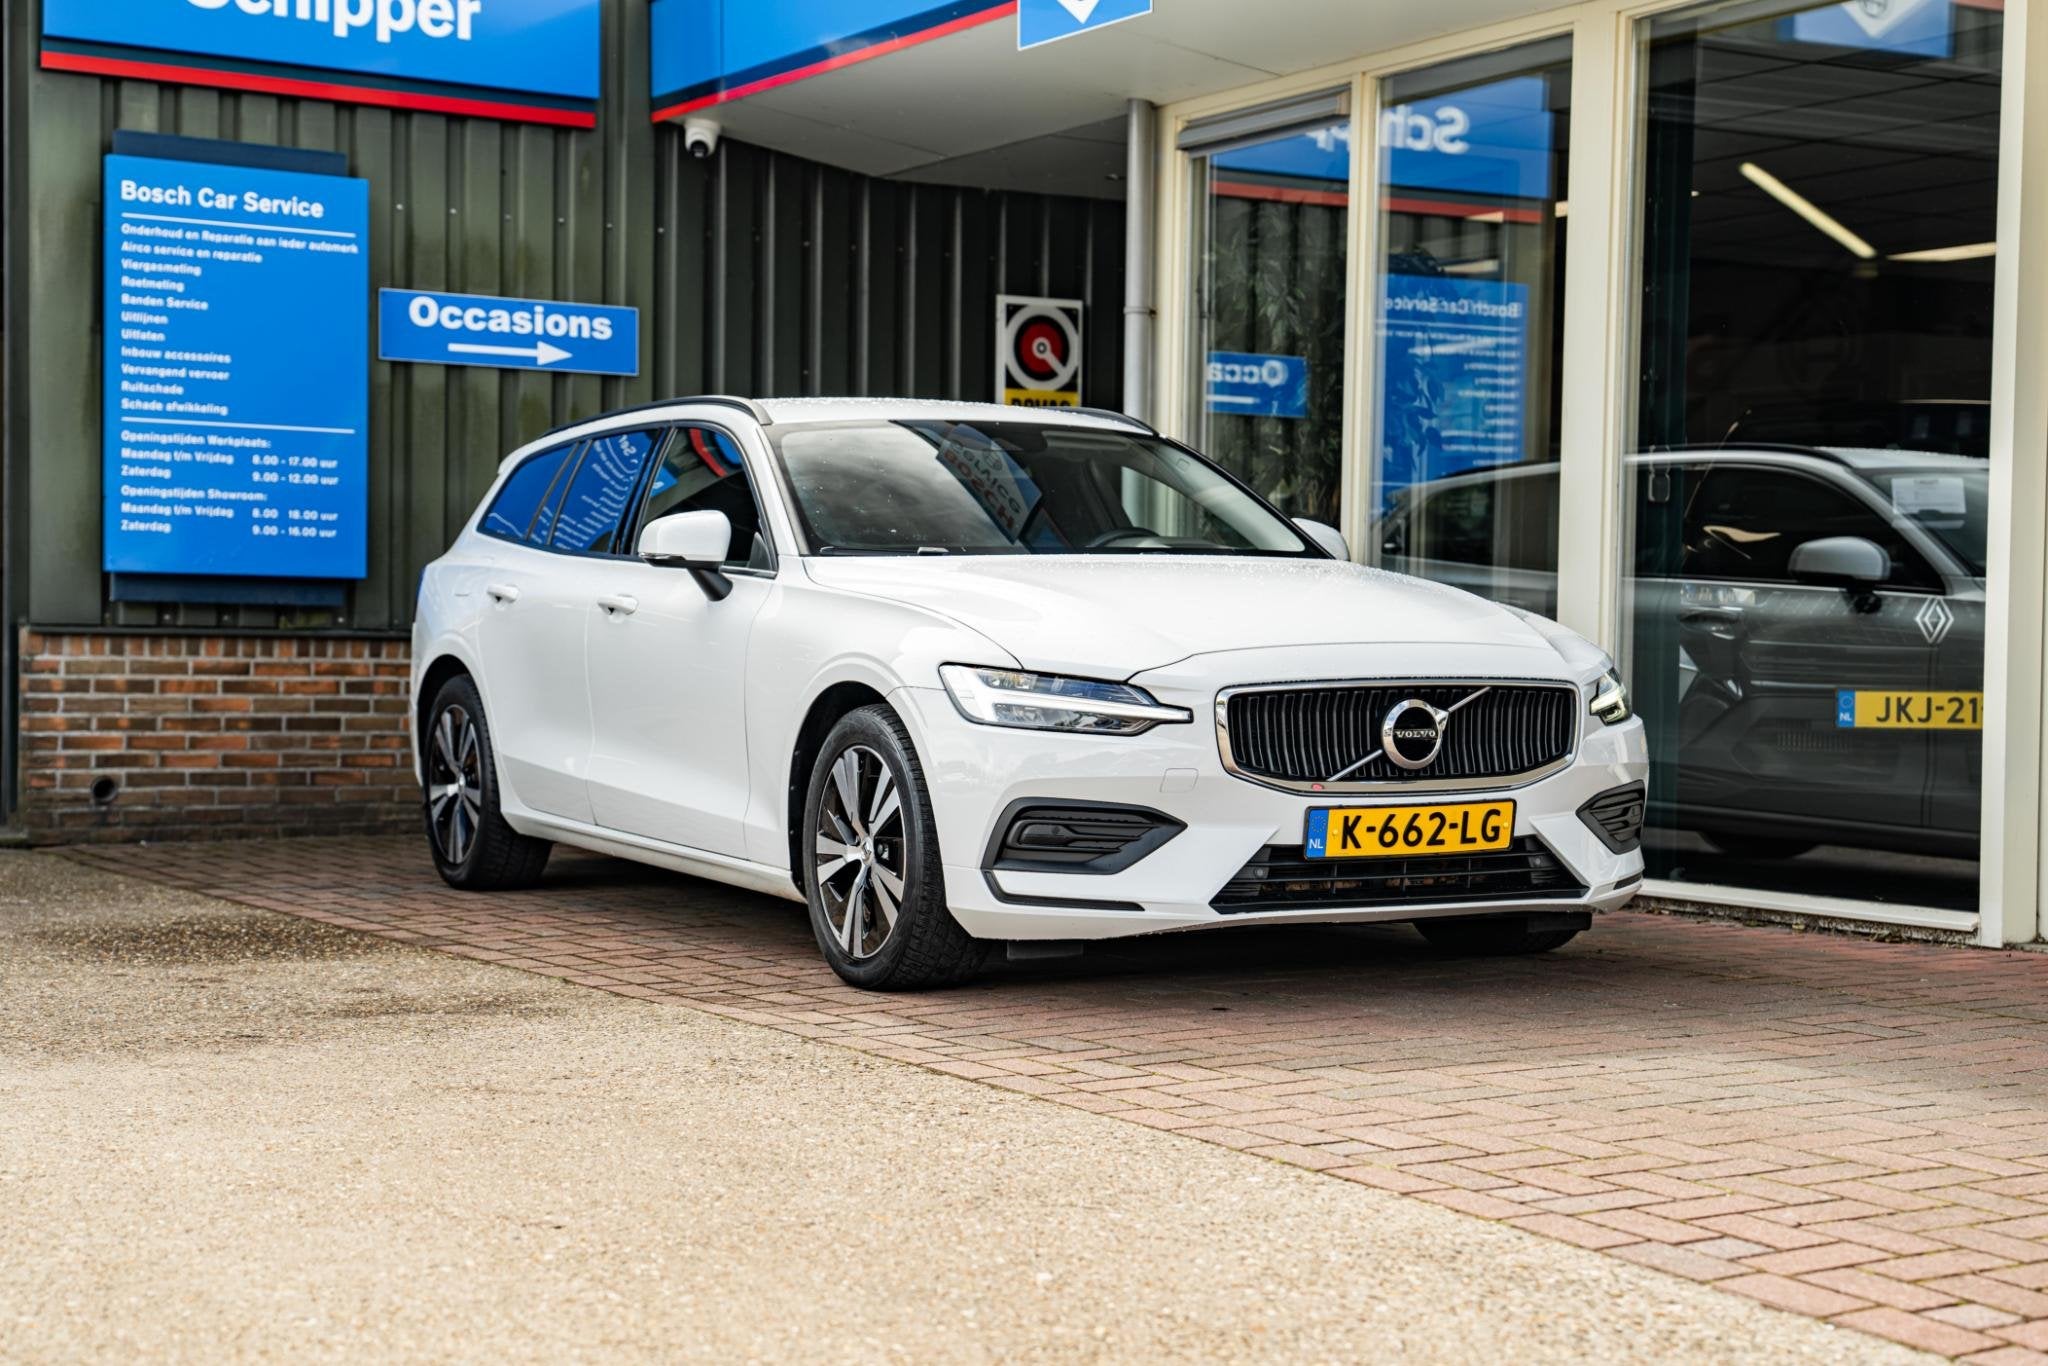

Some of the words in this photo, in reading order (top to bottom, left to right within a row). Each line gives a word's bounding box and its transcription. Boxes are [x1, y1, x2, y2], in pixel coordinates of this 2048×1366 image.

[121, 180, 191, 206] Bosch
[198, 187, 238, 210] Car
[243, 191, 324, 218] Service
[121, 223, 183, 239] Onderhoud
[185, 230, 199, 240] en
[202, 230, 254, 245] Reparatie
[256, 237, 276, 247] aan
[278, 237, 306, 249] ieder
[308, 239, 359, 254] automerk
[121, 241, 152, 254] Airco
[153, 244, 194, 257] service
[197, 247, 211, 258] en
[212, 250, 263, 263] reparatie
[121, 258, 202, 276] Viergasmeting
[121, 275, 185, 293] Roetmeting
[121, 293, 164, 307] Banden
[166, 297, 209, 310] Service
[121, 311, 169, 325] Uitlijnen
[409, 296, 613, 340] Occasions
[121, 346, 162, 359] Inbouw
[164, 350, 232, 364] accessoires
[121, 363, 187, 378] Vervangend
[189, 369, 230, 380] vervoer
[121, 381, 184, 395] Ruitschade
[121, 398, 164, 412] Schade
[166, 400, 229, 416] afwikkeling
[121, 430, 205, 446] Openingstijden
[207, 433, 272, 449] Werkplaats:
[121, 448, 172, 462] Maandag
[173, 450, 193, 462] t/m
[194, 450, 234, 465] Vrijdag
[319, 458, 338, 469] uur
[121, 464, 172, 479] Zaterdag
[320, 476, 339, 486] uur
[121, 485, 205, 500] Openingstijden
[207, 487, 268, 502] Showroom:
[121, 502, 172, 516] Maandag
[173, 505, 193, 516] t/m
[194, 505, 234, 518] Vrijdag
[320, 512, 338, 522] uur
[121, 519, 172, 533] Zaterdag
[319, 529, 337, 539] uur
[1839, 712, 1853, 721] NL
[1876, 697, 1983, 724] JKJ-21
[1395, 730, 1436, 738] VOLVO
[1309, 838, 1324, 849] NL
[1341, 809, 1502, 849] K-662-LG
